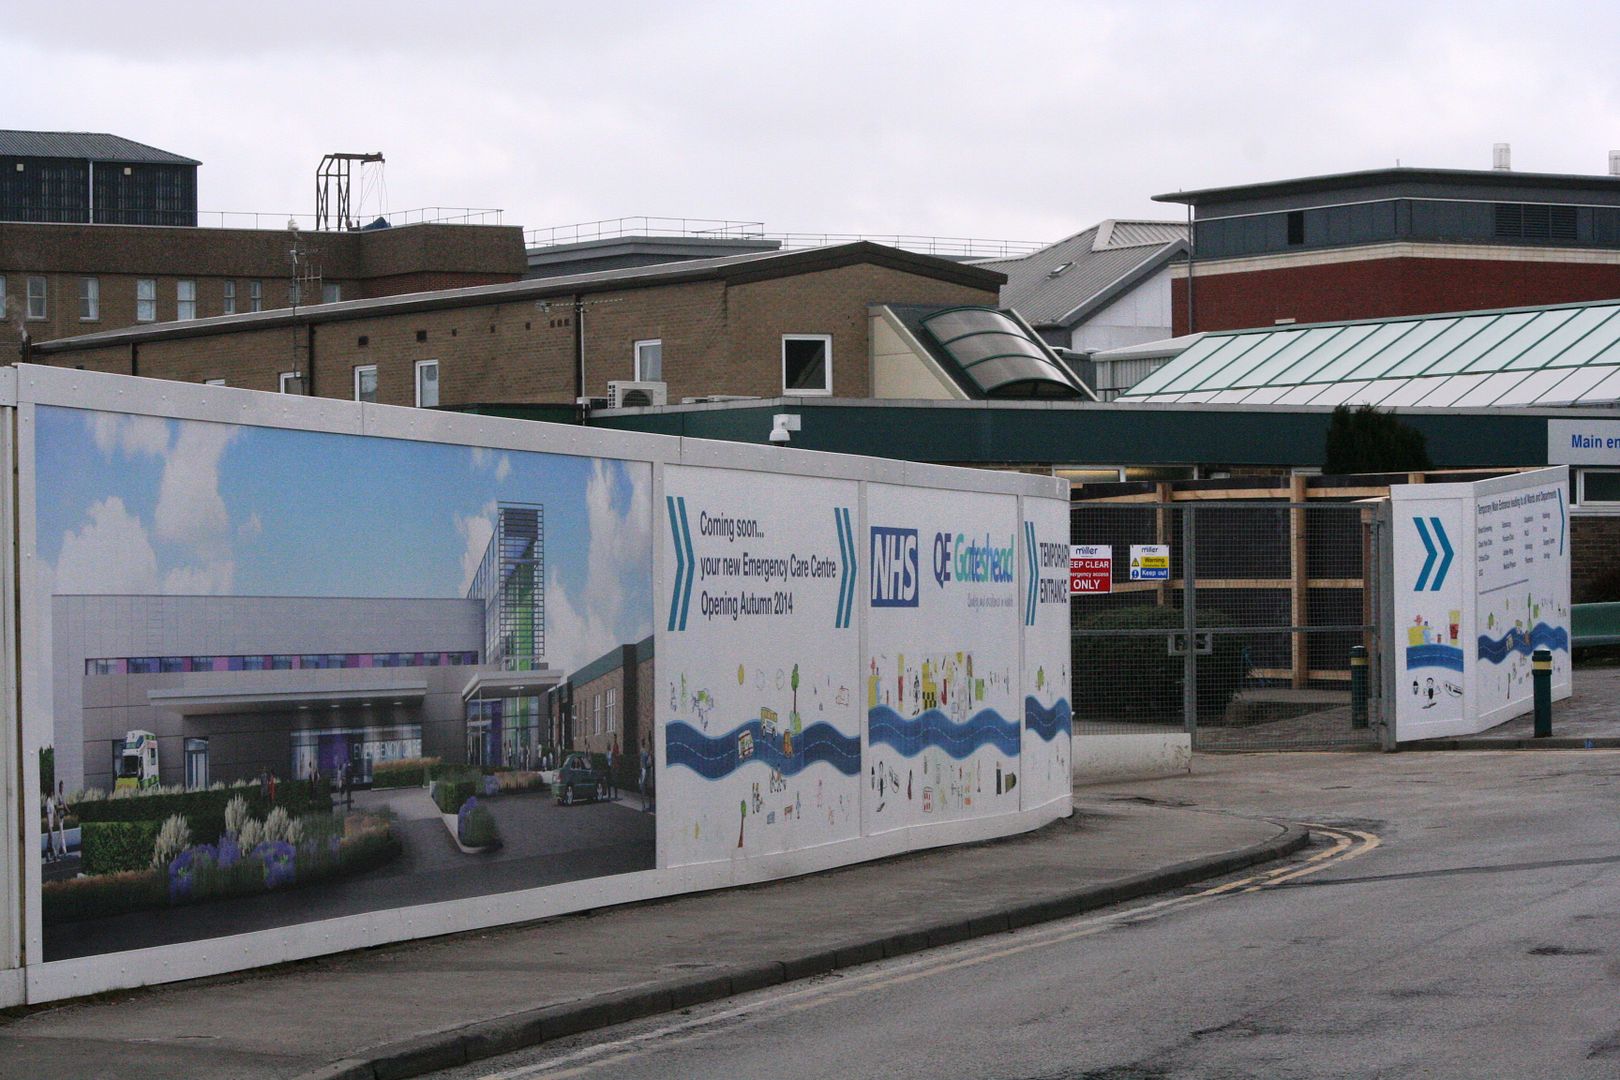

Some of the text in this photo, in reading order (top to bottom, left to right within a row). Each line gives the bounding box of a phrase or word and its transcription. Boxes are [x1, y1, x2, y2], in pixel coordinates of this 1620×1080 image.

[1571, 434, 1603, 449] Main
[700, 510, 735, 542] Coming
[933, 532, 1014, 589] QE Gateshead
[1039, 542, 1070, 568] TEMPORARY
[1075, 546, 1098, 555] miller
[700, 552, 836, 582] your new Emergency Care Centre
[872, 534, 917, 601] NHS
[1070, 560, 1109, 569] EEP CLEAR
[1141, 569, 1167, 577] Keep out
[1040, 578, 1067, 604] ENTRANCE
[1073, 579, 1100, 589] ONLY
[700, 590, 793, 621] Opening Autumn 2014
